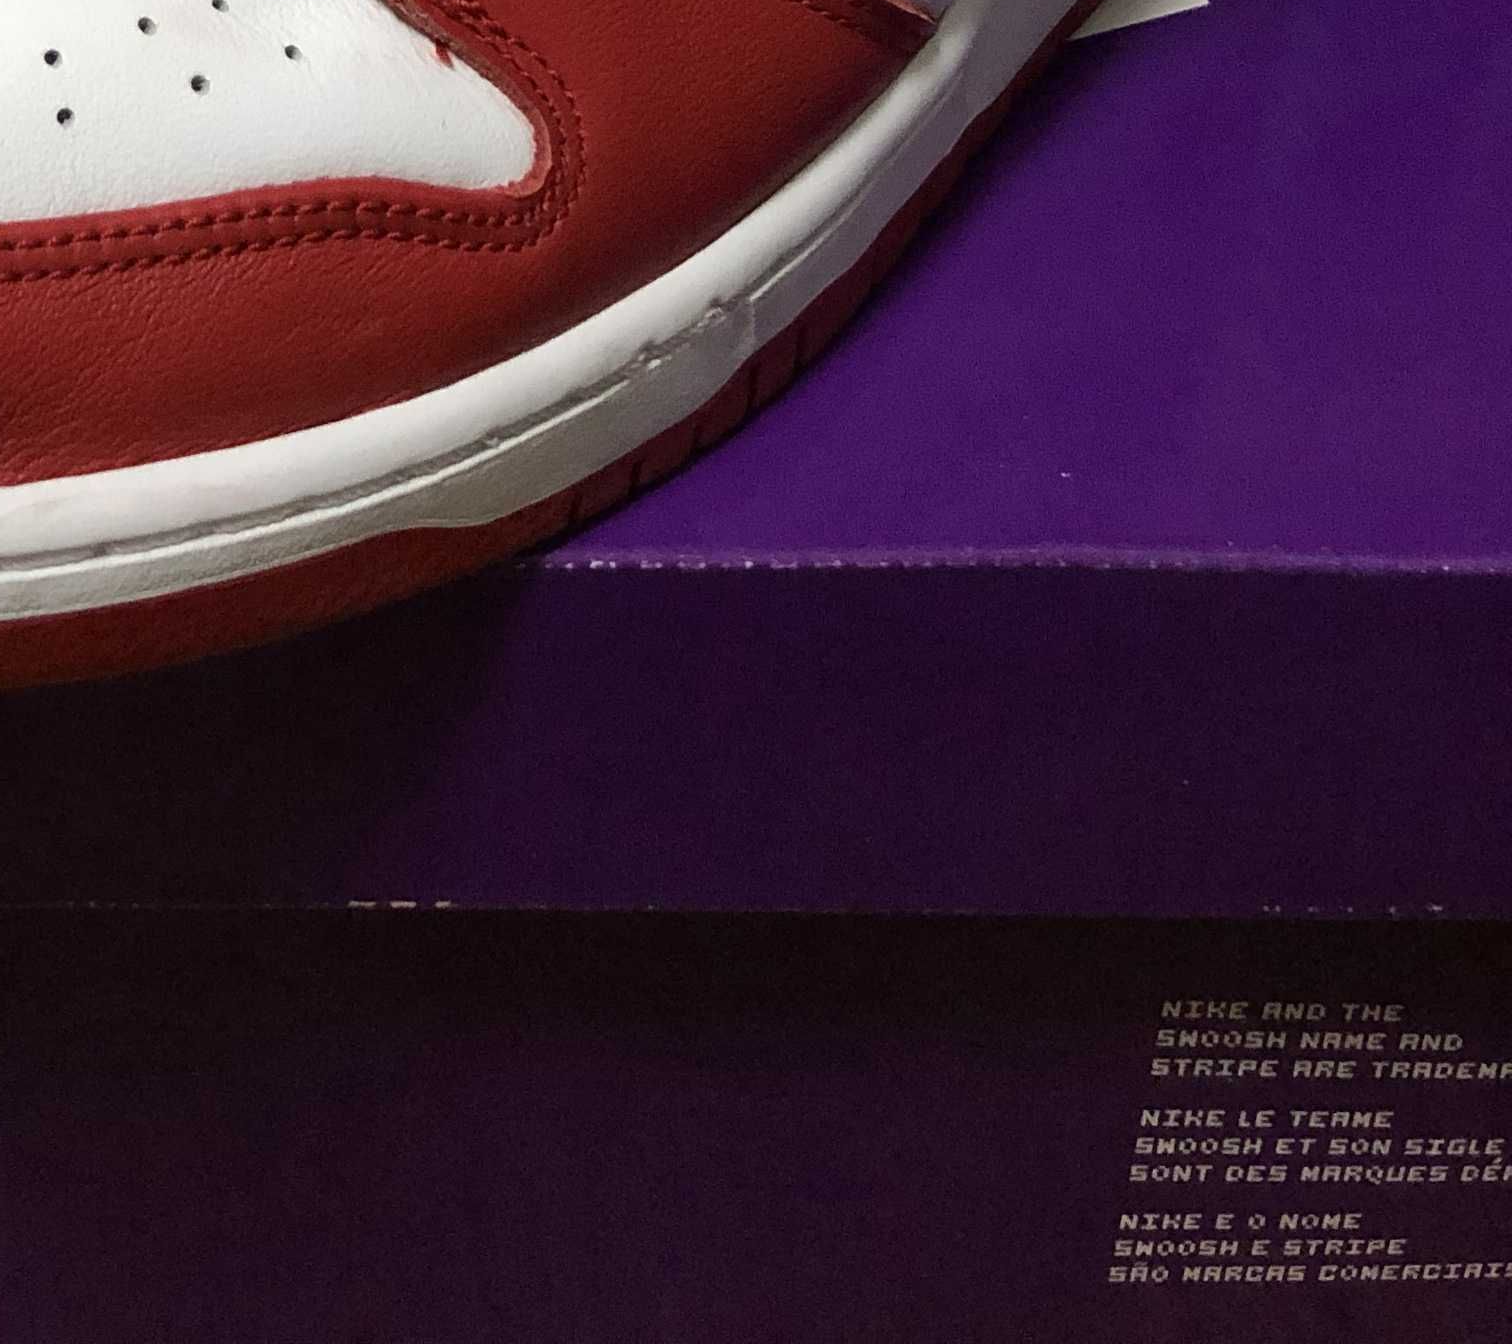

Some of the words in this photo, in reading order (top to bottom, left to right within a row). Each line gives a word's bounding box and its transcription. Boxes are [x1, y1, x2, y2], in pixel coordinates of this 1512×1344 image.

[1161, 1000, 1249, 1019] NIKE
[1262, 1002, 1326, 1020] AND
[1342, 1003, 1405, 1022] THE
[1155, 1030, 1287, 1049] SWOOSH
[1300, 1032, 1387, 1051] NAME
[1399, 1034, 1464, 1051] AND
[1150, 1059, 1279, 1077] STRIPE
[1293, 1060, 1356, 1079] ARE
[1140, 1110, 1225, 1127] NIKE
[1238, 1110, 1275, 1128] LE
[1134, 1138, 1263, 1155] SWOOSH
[1275, 1138, 1317, 1155] ET
[1328, 1139, 1392, 1156] SON
[1404, 1139, 1504, 1156] SIGLE
[1128, 1166, 1213, 1182] SONT
[1225, 1166, 1288, 1183] DES
[1300, 1166, 1448, 1185] MARQUES
[1119, 1214, 1202, 1230] NIKE
[1215, 1214, 1234, 1230] E
[1279, 1214, 1362, 1230] NOME
[1113, 1240, 1239, 1257] SWOOSH
[1251, 1240, 1271, 1256] E
[1283, 1239, 1407, 1256] STRIPE
[1108, 1261, 1169, 1283] SÃO
[1181, 1265, 1307, 1283] MARCAS
